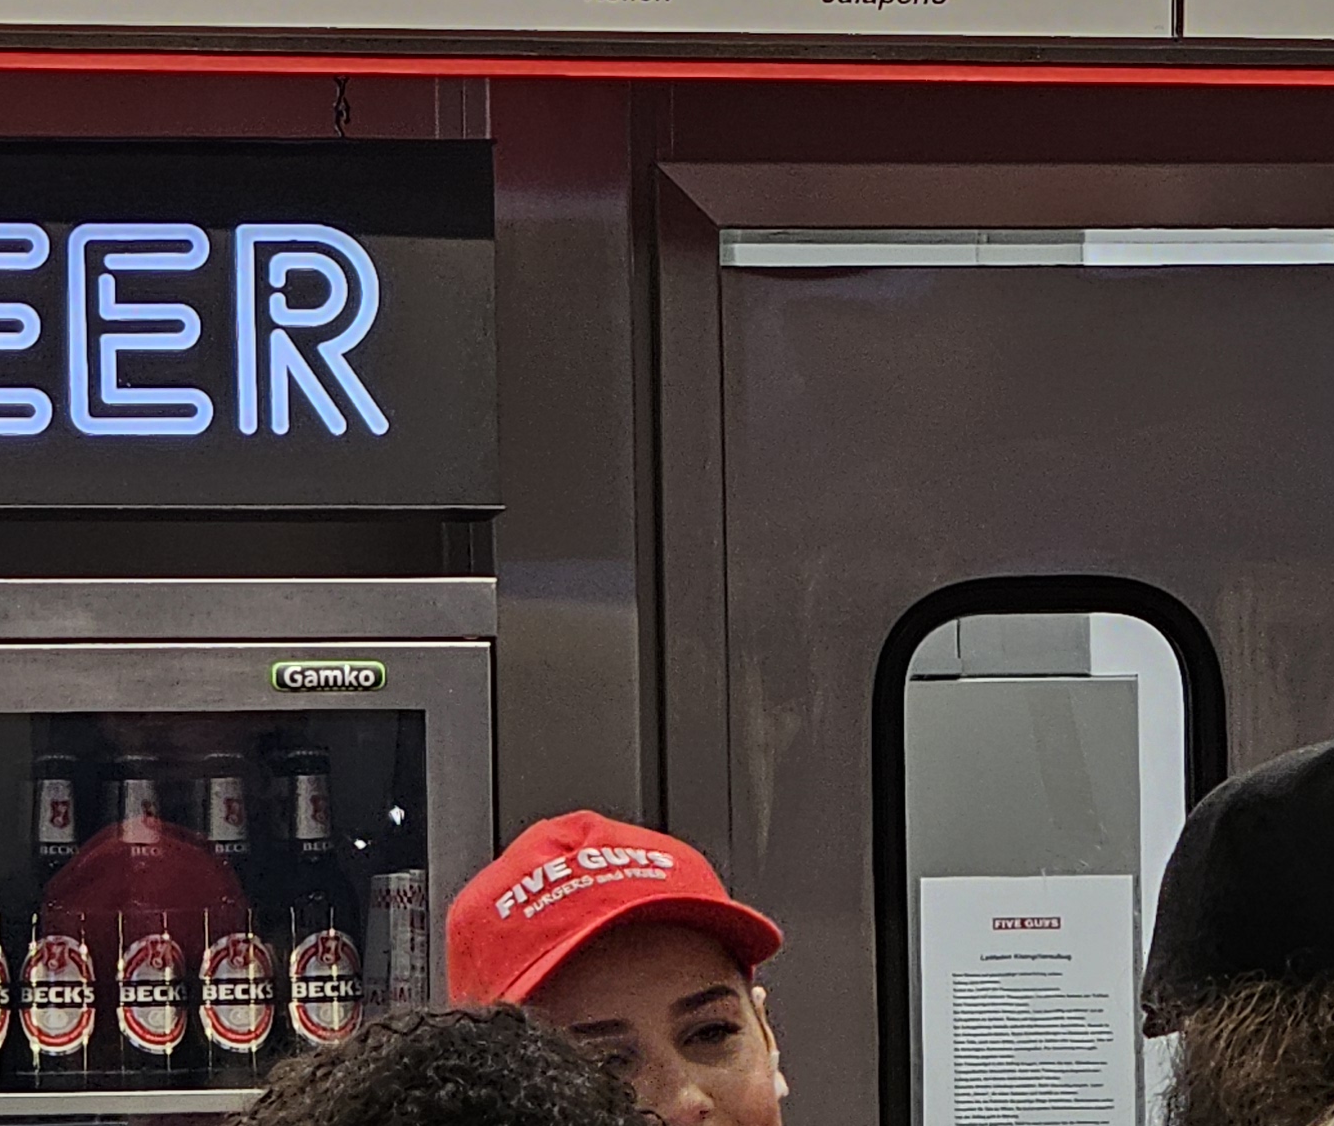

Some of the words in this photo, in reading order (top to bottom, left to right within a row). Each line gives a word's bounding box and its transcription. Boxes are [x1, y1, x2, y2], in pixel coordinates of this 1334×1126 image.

[283, 665, 374, 688] Gamko
[495, 855, 571, 920] FIVE
[576, 847, 675, 870] GUYS
[995, 919, 1021, 929] FIVE
[1024, 918, 1059, 928] GUYS
